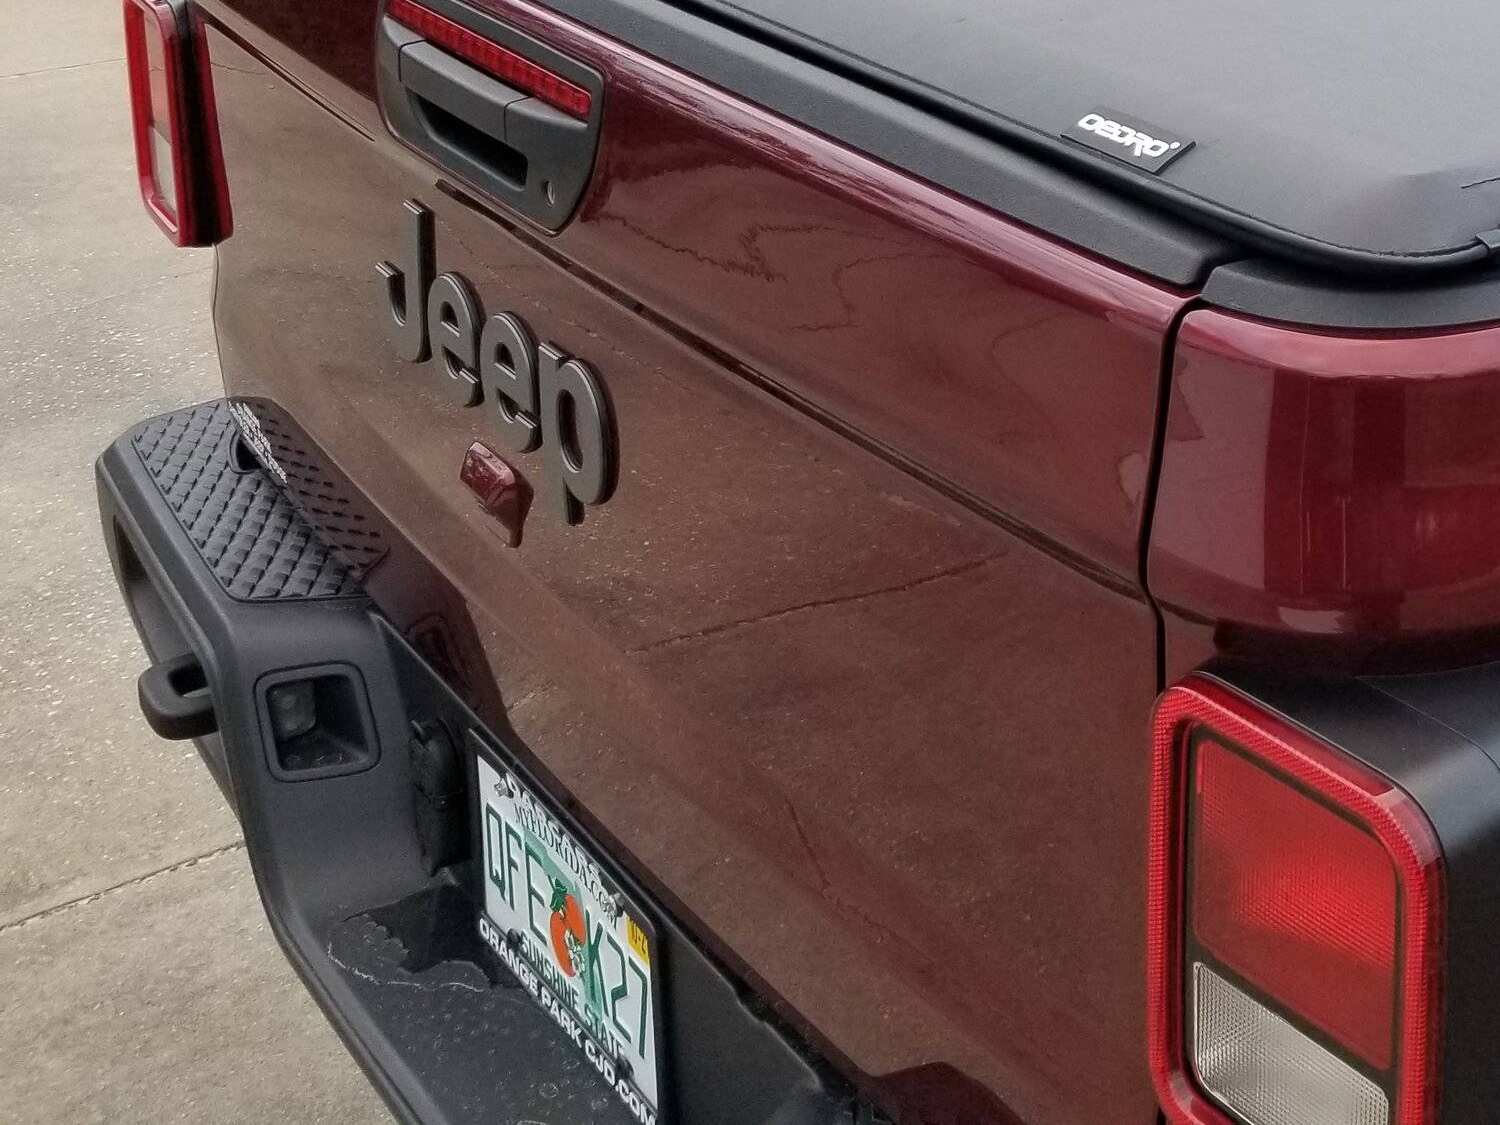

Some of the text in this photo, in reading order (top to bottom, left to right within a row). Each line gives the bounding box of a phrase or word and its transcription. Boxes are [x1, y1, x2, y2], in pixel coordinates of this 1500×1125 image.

[375, 198, 619, 526] Jeep
[479, 917, 657, 1125] ORANGE PARK CJD.COM
[485, 802, 648, 1060] QFE K27
[520, 929, 579, 1018] SUNSHINE
